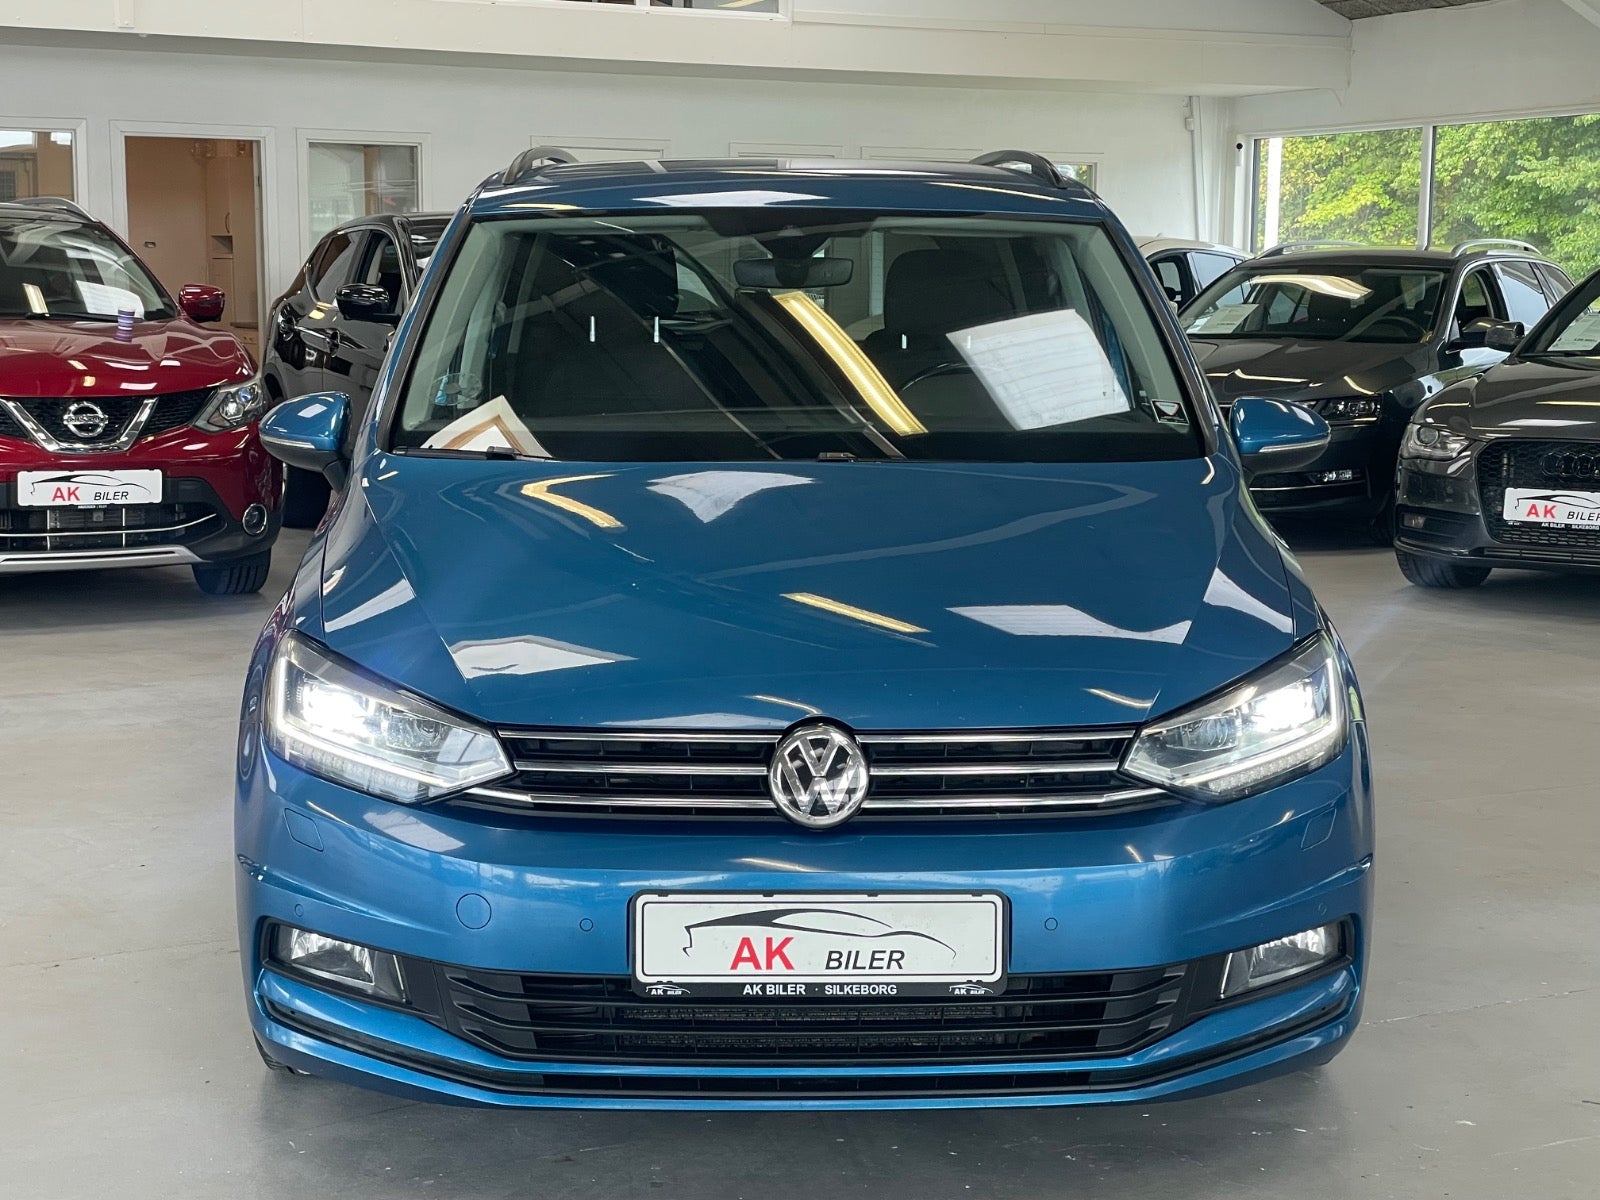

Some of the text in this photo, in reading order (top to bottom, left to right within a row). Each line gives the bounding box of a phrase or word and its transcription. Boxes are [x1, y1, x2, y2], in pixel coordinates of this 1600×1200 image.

[52, 486, 129, 501] AK BILER
[1526, 503, 1556, 519] AK
[730, 936, 906, 970] AK BILER
[650, 988, 664, 996] AK
[742, 984, 898, 995] AK BILER SILKEBORG
[954, 988, 967, 996] AK
